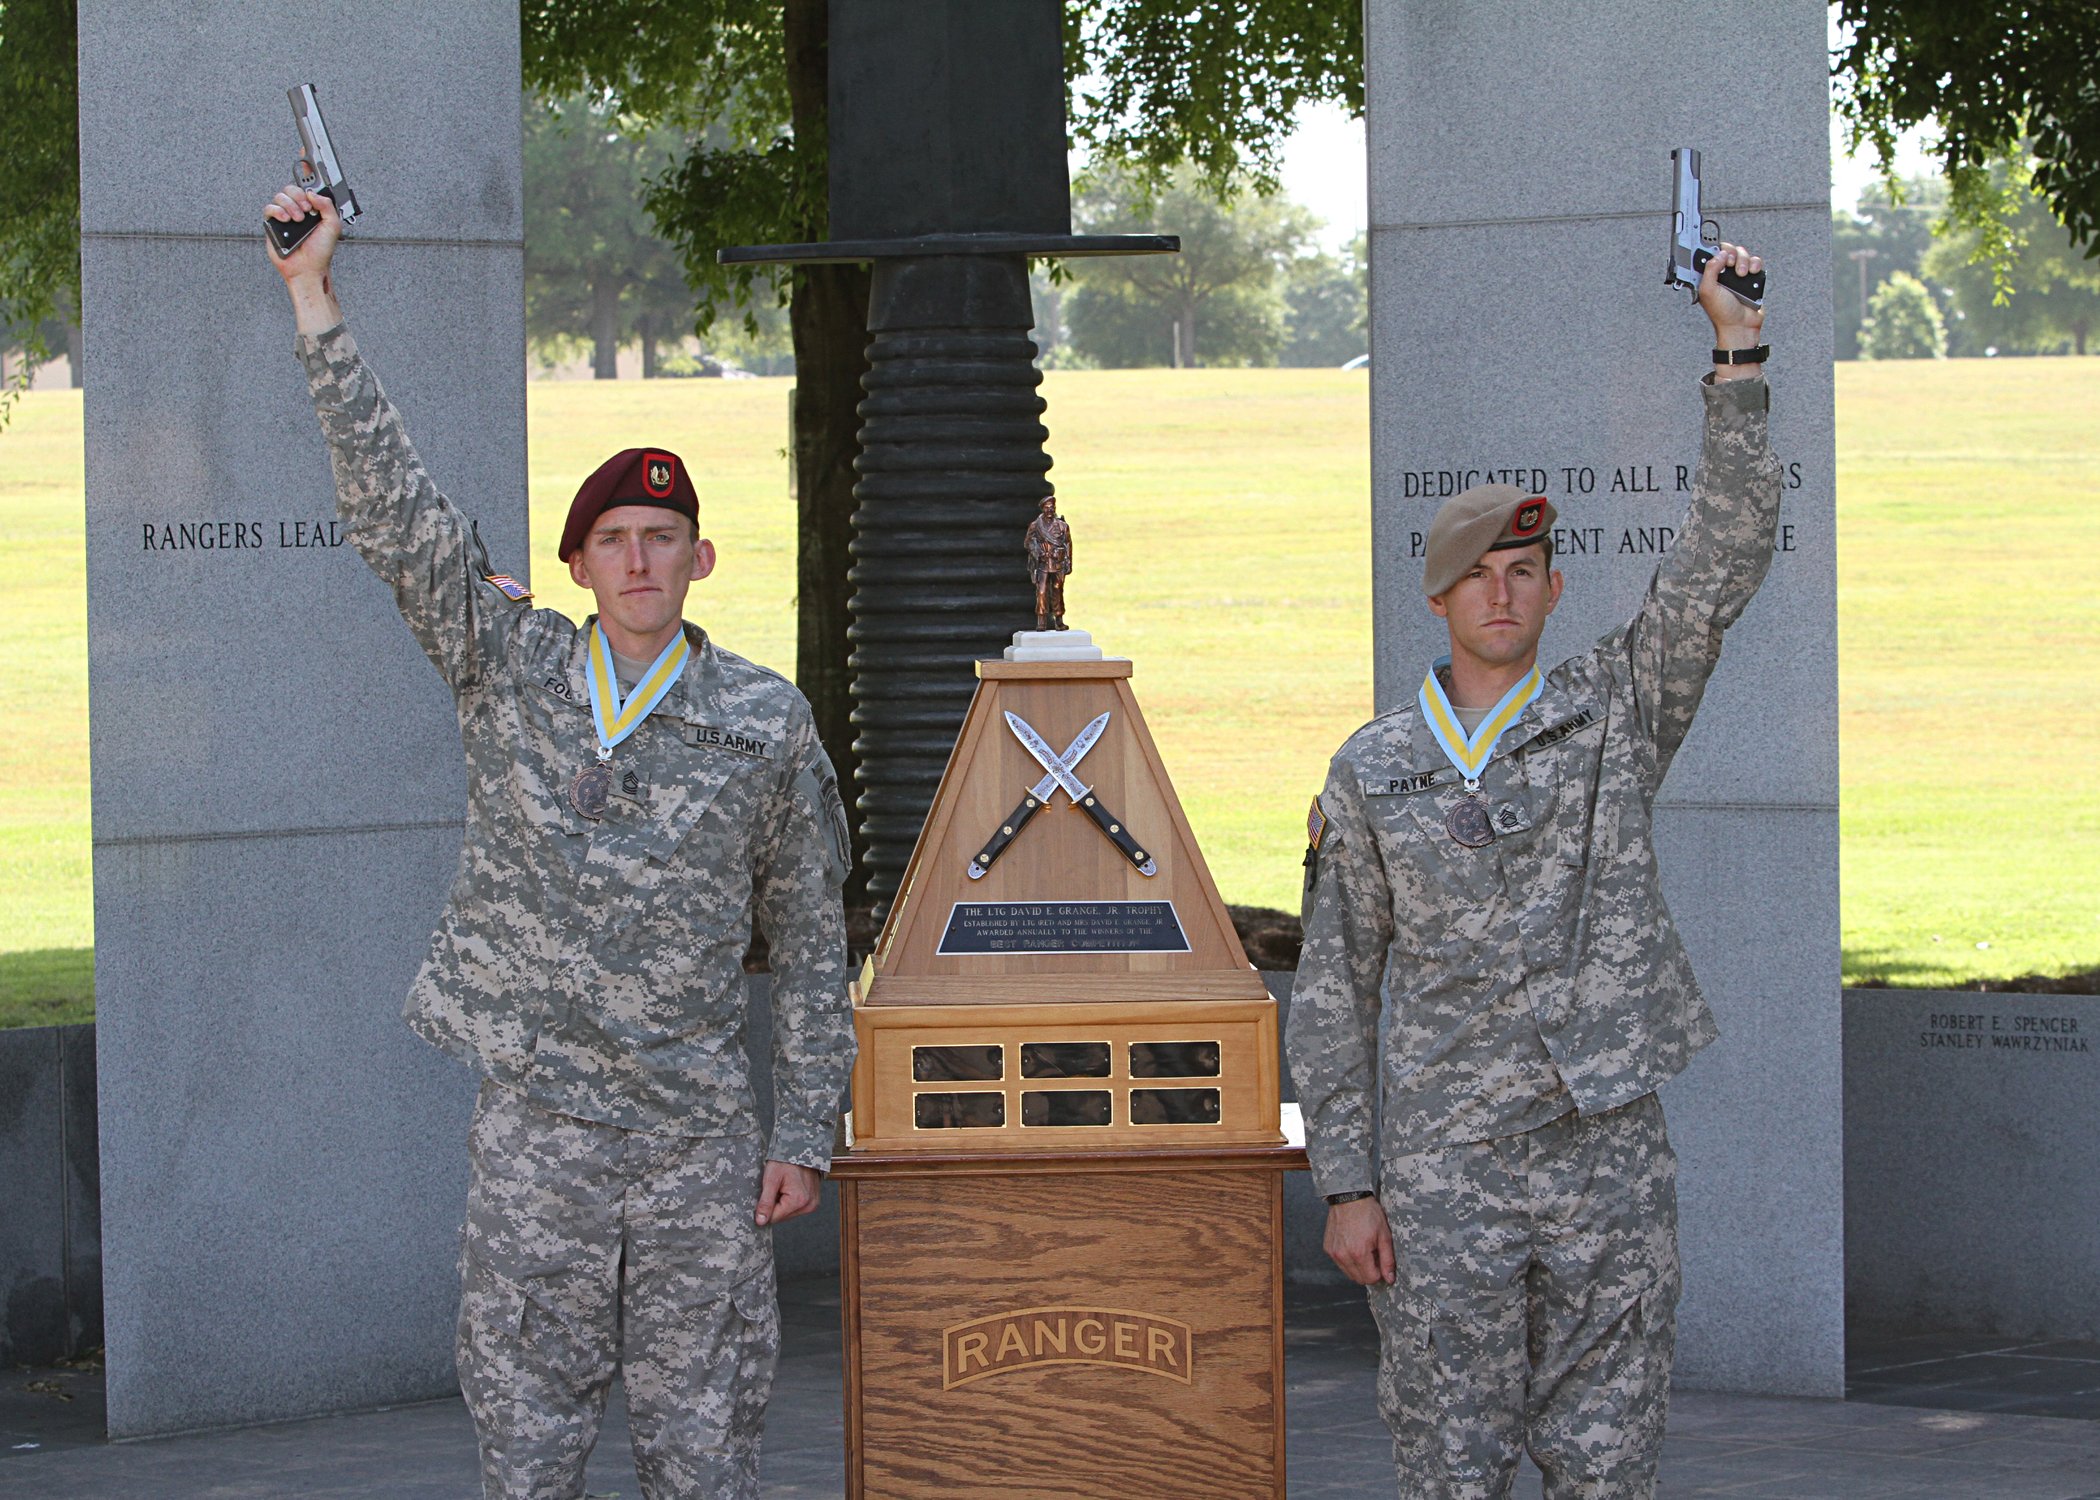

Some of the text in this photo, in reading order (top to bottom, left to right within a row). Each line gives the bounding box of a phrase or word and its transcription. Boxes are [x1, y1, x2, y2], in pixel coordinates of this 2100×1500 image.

[1403, 469, 1547, 497] DEDICATED
[1562, 466, 1595, 494] TO
[1610, 466, 1660, 492] ALL
[142, 521, 344, 550] RANGERS LEAD
[1618, 527, 1675, 554] AND
[1389, 772, 1435, 792] PAYNE
[963, 907, 983, 916] THE
[988, 907, 1006, 916] LTG
[1011, 906, 1042, 916] DAVID
[1125, 905, 1164, 915] TROPHY
[963, 919, 1008, 927] ESTABLISHED
[1010, 919, 1020, 927] BY
[1091, 918, 1112, 926] DAVID
[1017, 928, 1058, 936] ANNUALLY
[1061, 928, 1071, 936] TO
[1091, 927, 1123, 935] WINNERS
[1139, 927, 1153, 935] THE
[1930, 1014, 1984, 1030] ROBERT
[2014, 1016, 2079, 1033] SPENCER
[1920, 1032, 2089, 1052] STANLEY WAWRZYNIAK
[957, 1318, 1179, 1375] RANGER
